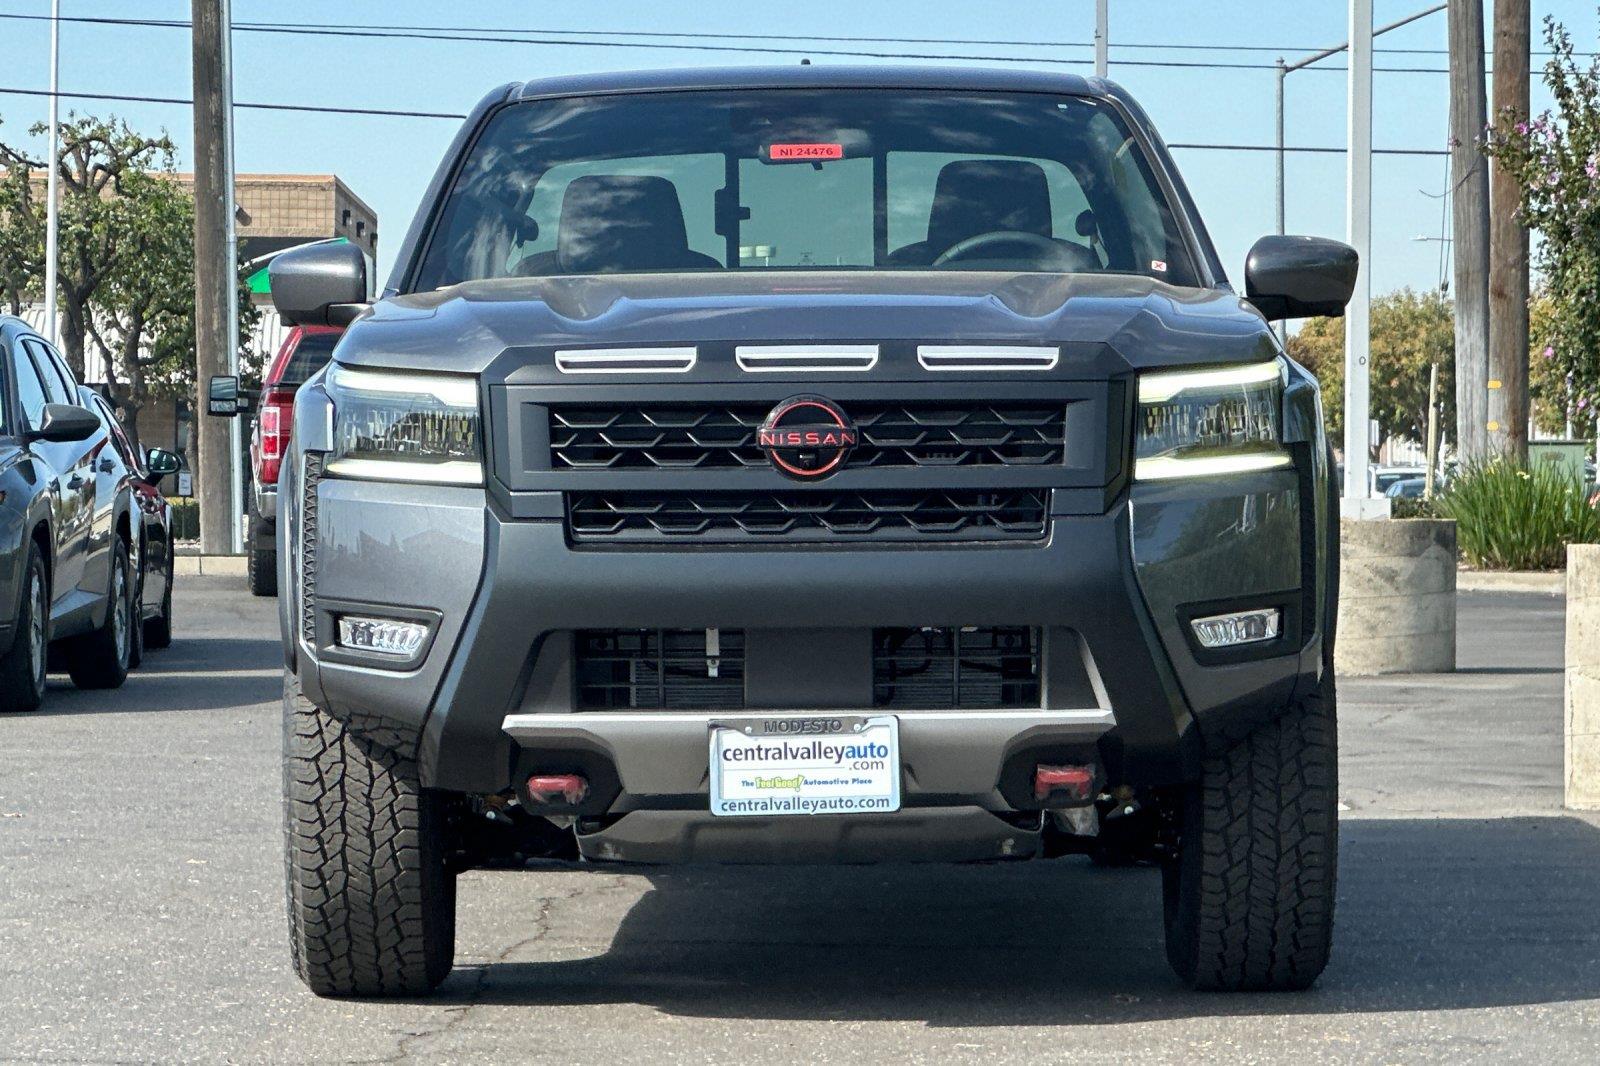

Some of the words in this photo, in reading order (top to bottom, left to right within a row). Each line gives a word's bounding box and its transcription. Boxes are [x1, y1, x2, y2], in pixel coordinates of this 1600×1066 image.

[797, 148, 833, 156] 24476
[760, 431, 855, 446] NISSAN
[764, 719, 843, 733] MODESTO
[849, 759, 885, 771] .com
[721, 797, 890, 812] centralvalleyauto.com
